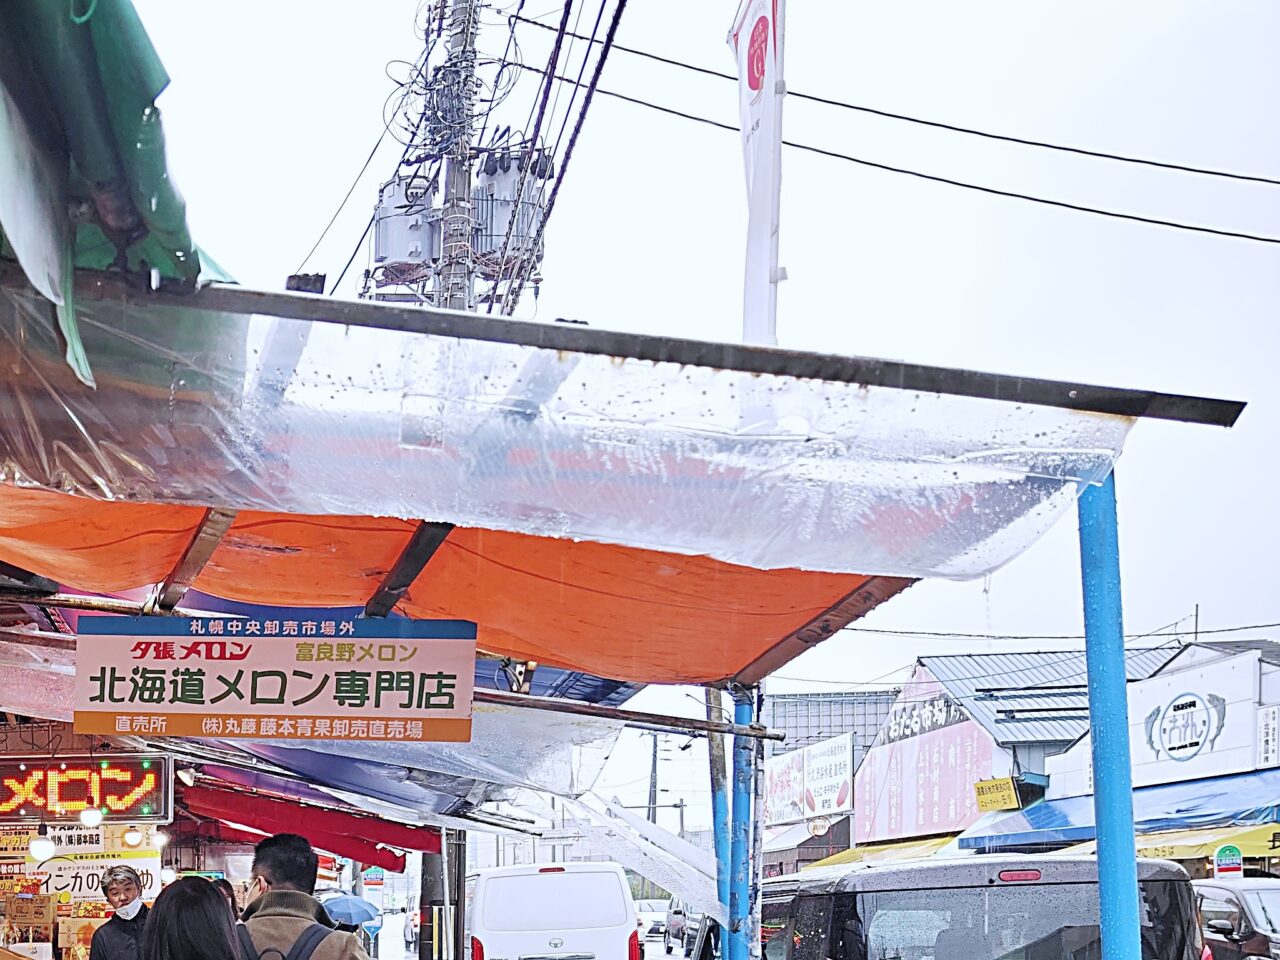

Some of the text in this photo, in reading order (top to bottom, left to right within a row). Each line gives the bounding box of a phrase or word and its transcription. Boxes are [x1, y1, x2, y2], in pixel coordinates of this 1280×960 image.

[190, 619, 355, 636] 札幌中央卸売市場外
[131, 641, 418, 662] 夕張メロン 富良野メロン
[89, 666, 457, 709] 北海道メロン専門店
[115, 715, 167, 733] 直売所
